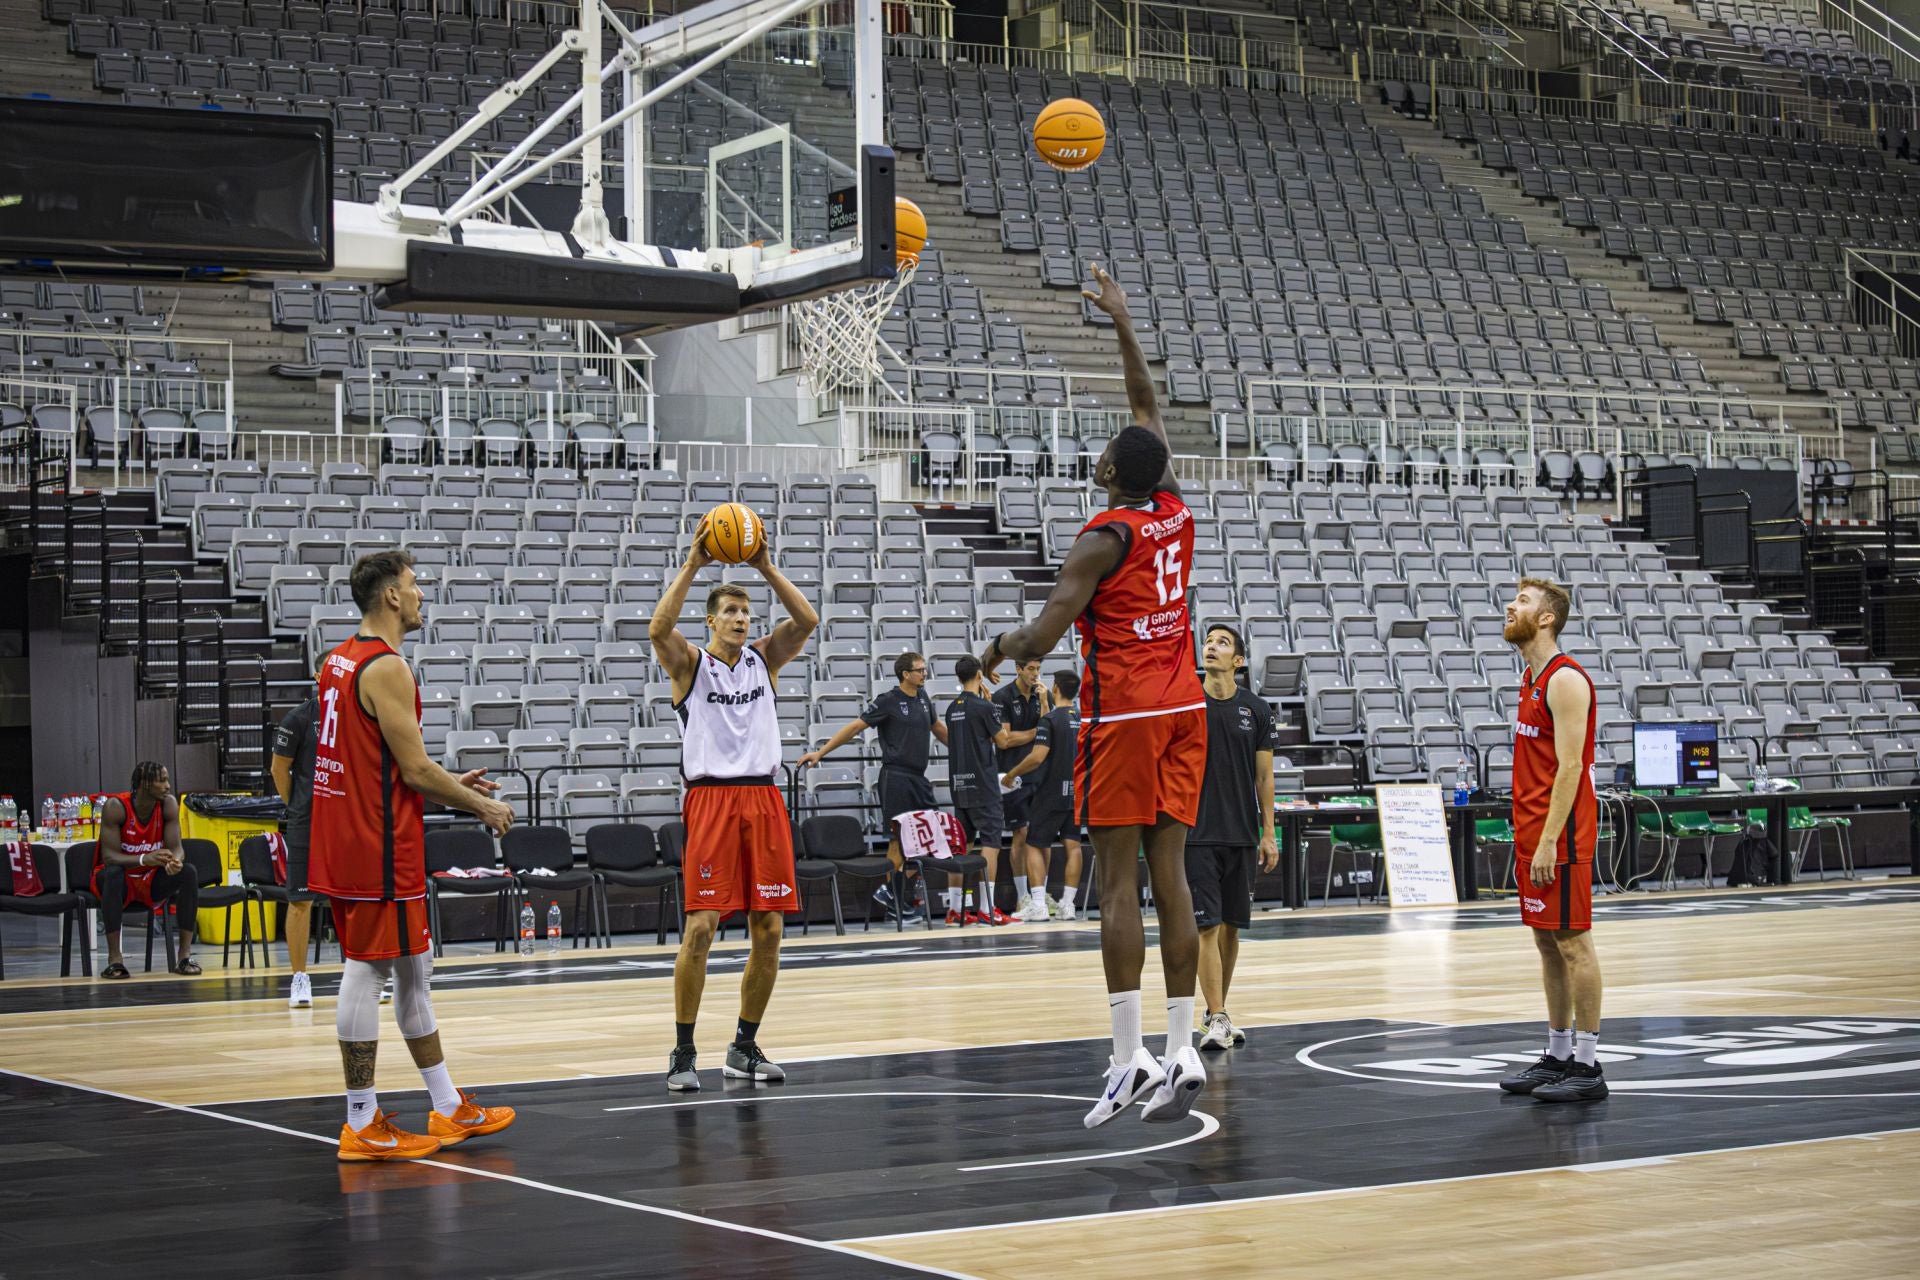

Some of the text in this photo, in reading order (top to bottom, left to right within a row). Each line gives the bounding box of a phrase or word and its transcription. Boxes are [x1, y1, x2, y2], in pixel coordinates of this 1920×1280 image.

[830, 203, 843, 217] liga
[723, 521, 732, 538] acb
[740, 507, 754, 547] Wilson
[1153, 540, 1183, 606] 15
[1692, 746, 1710, 757] 14:58
[756, 883, 781, 891] Granada
[760, 890, 780, 898] Digital
